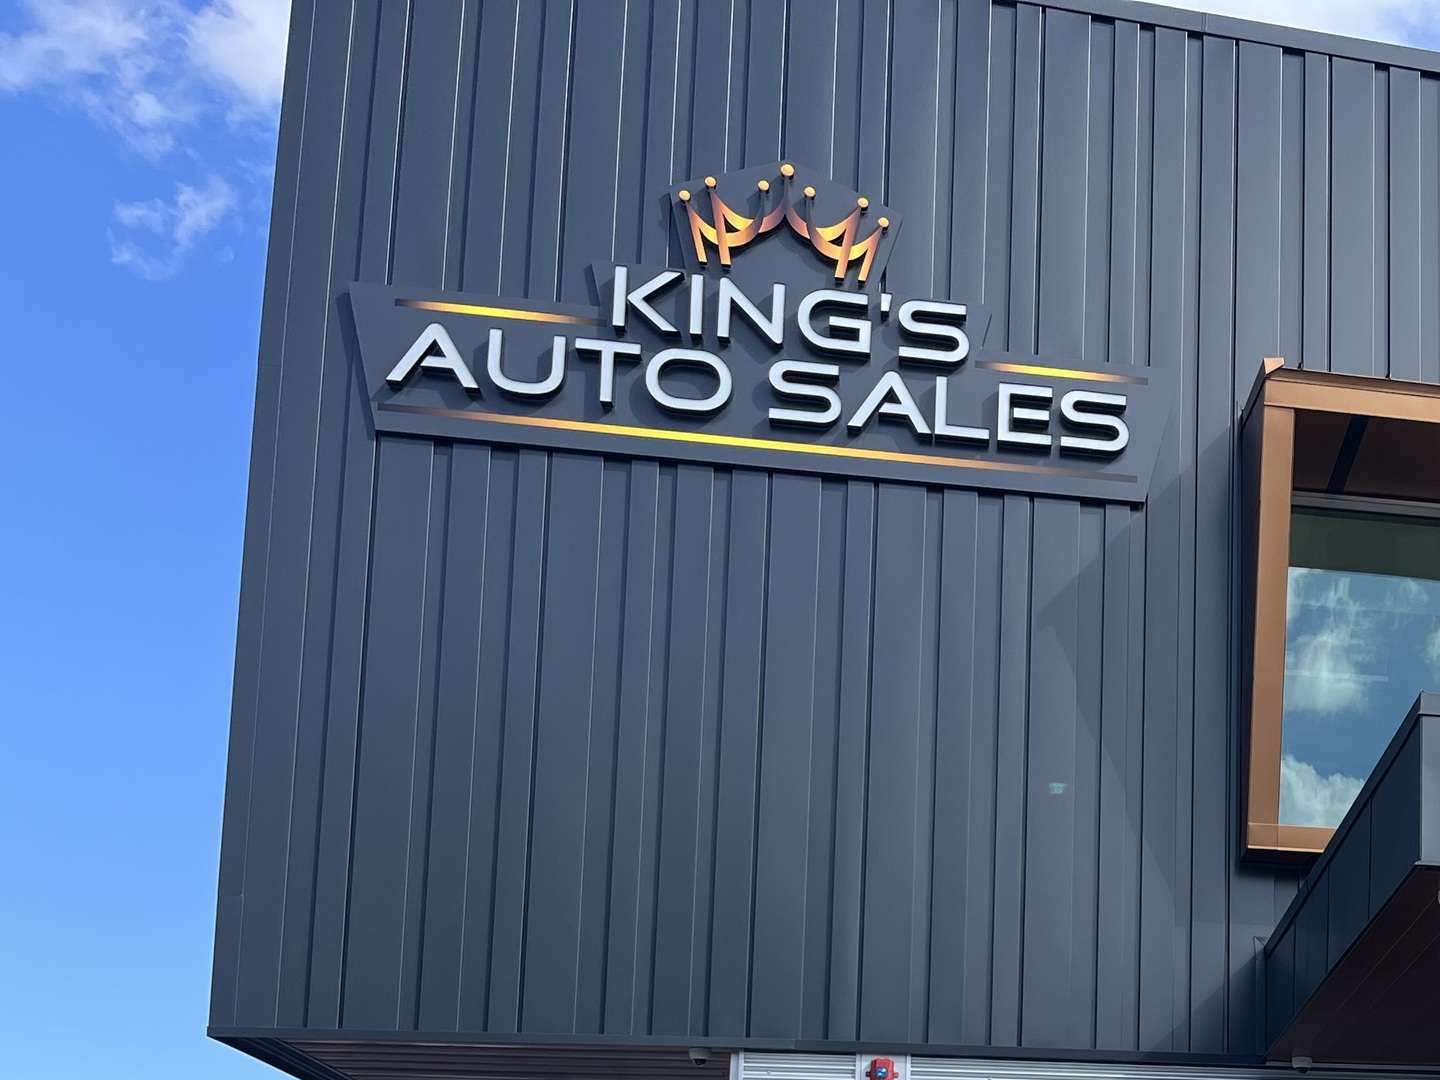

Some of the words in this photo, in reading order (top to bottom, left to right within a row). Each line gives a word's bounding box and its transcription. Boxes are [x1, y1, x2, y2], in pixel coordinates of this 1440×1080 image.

[611, 264, 970, 365] KING'S
[385, 321, 734, 413] AUTO
[767, 359, 1130, 454] SALES
